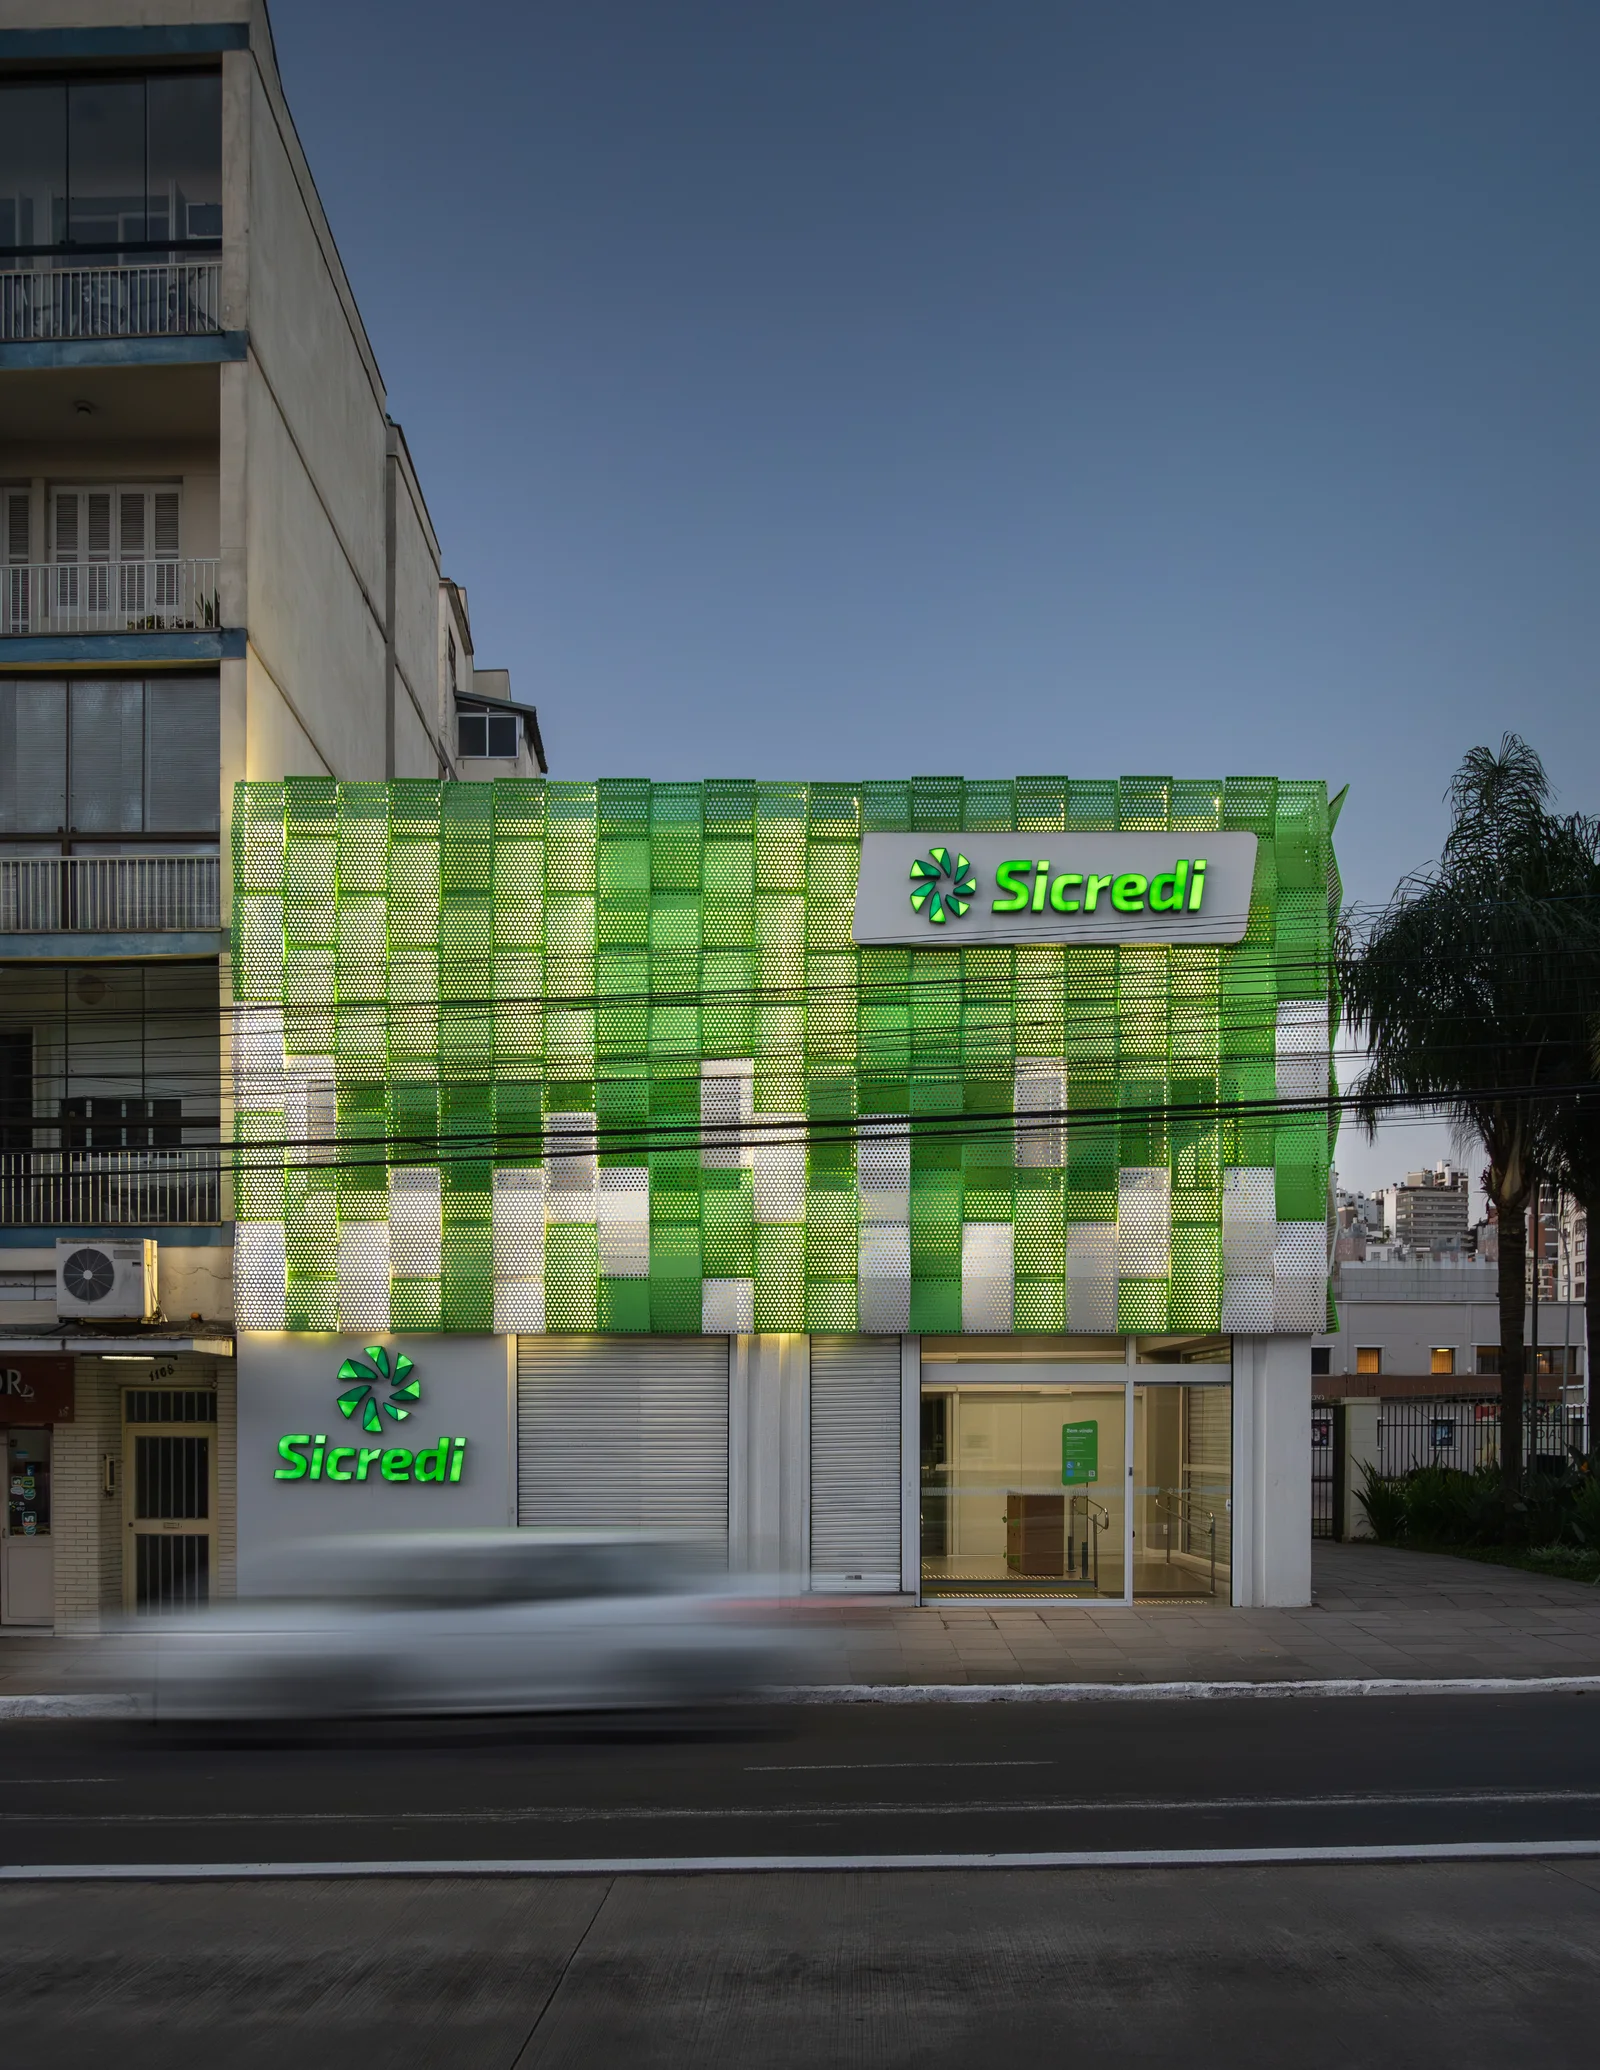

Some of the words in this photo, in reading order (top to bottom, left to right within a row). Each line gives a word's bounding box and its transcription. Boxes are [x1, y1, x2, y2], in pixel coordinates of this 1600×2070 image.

[992, 859, 1207, 914] Sicredi
[0, 1368, 21, 1395] R
[273, 1434, 467, 1482] Sicredi
